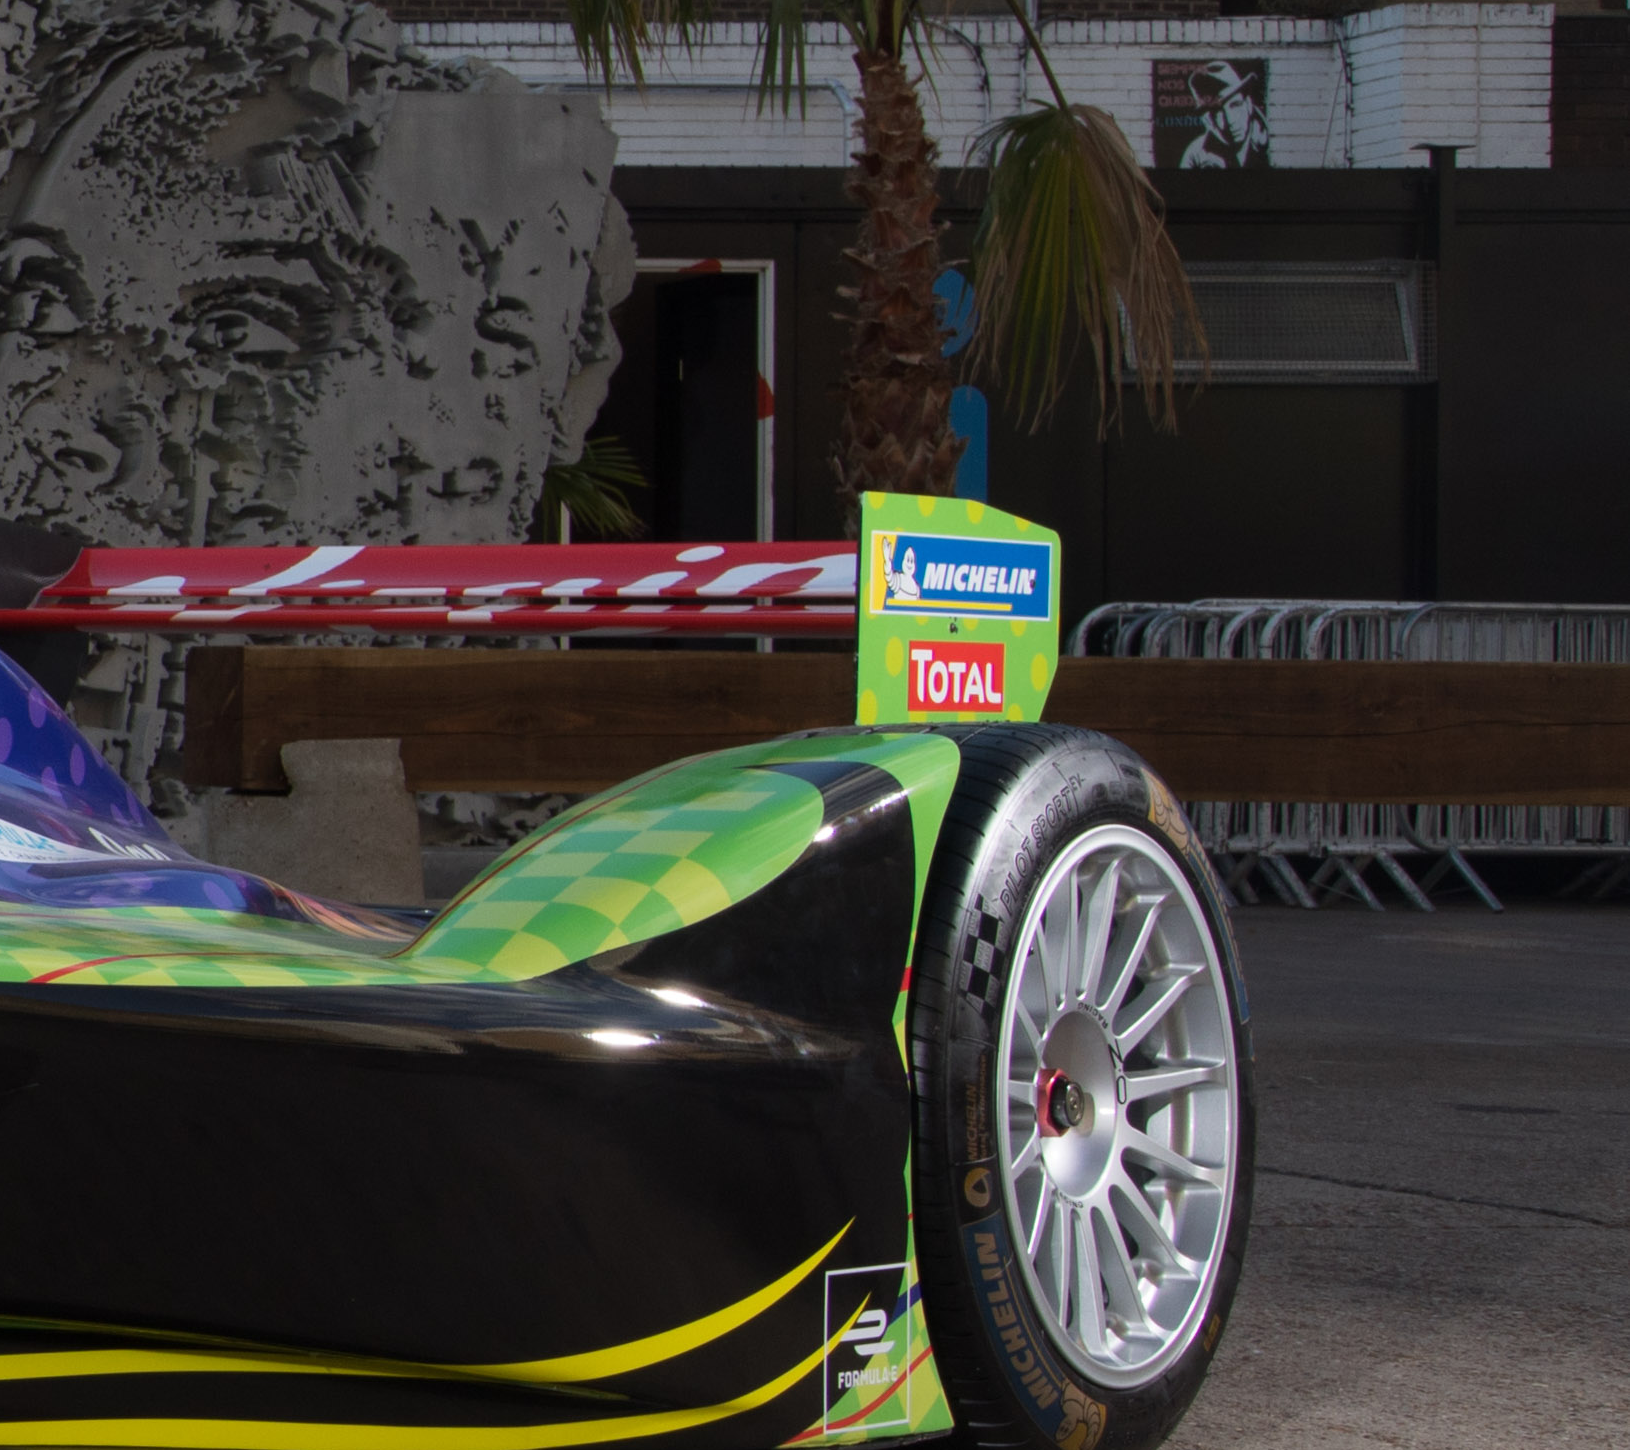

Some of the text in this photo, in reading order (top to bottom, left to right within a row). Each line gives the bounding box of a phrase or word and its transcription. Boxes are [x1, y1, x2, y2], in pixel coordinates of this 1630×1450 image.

[922, 558, 1037, 595] MICHELIN
[1000, 837, 1036, 917] PILOT
[1031, 785, 1073, 849] SPORT
[974, 1232, 1059, 1411] MICHELIN
